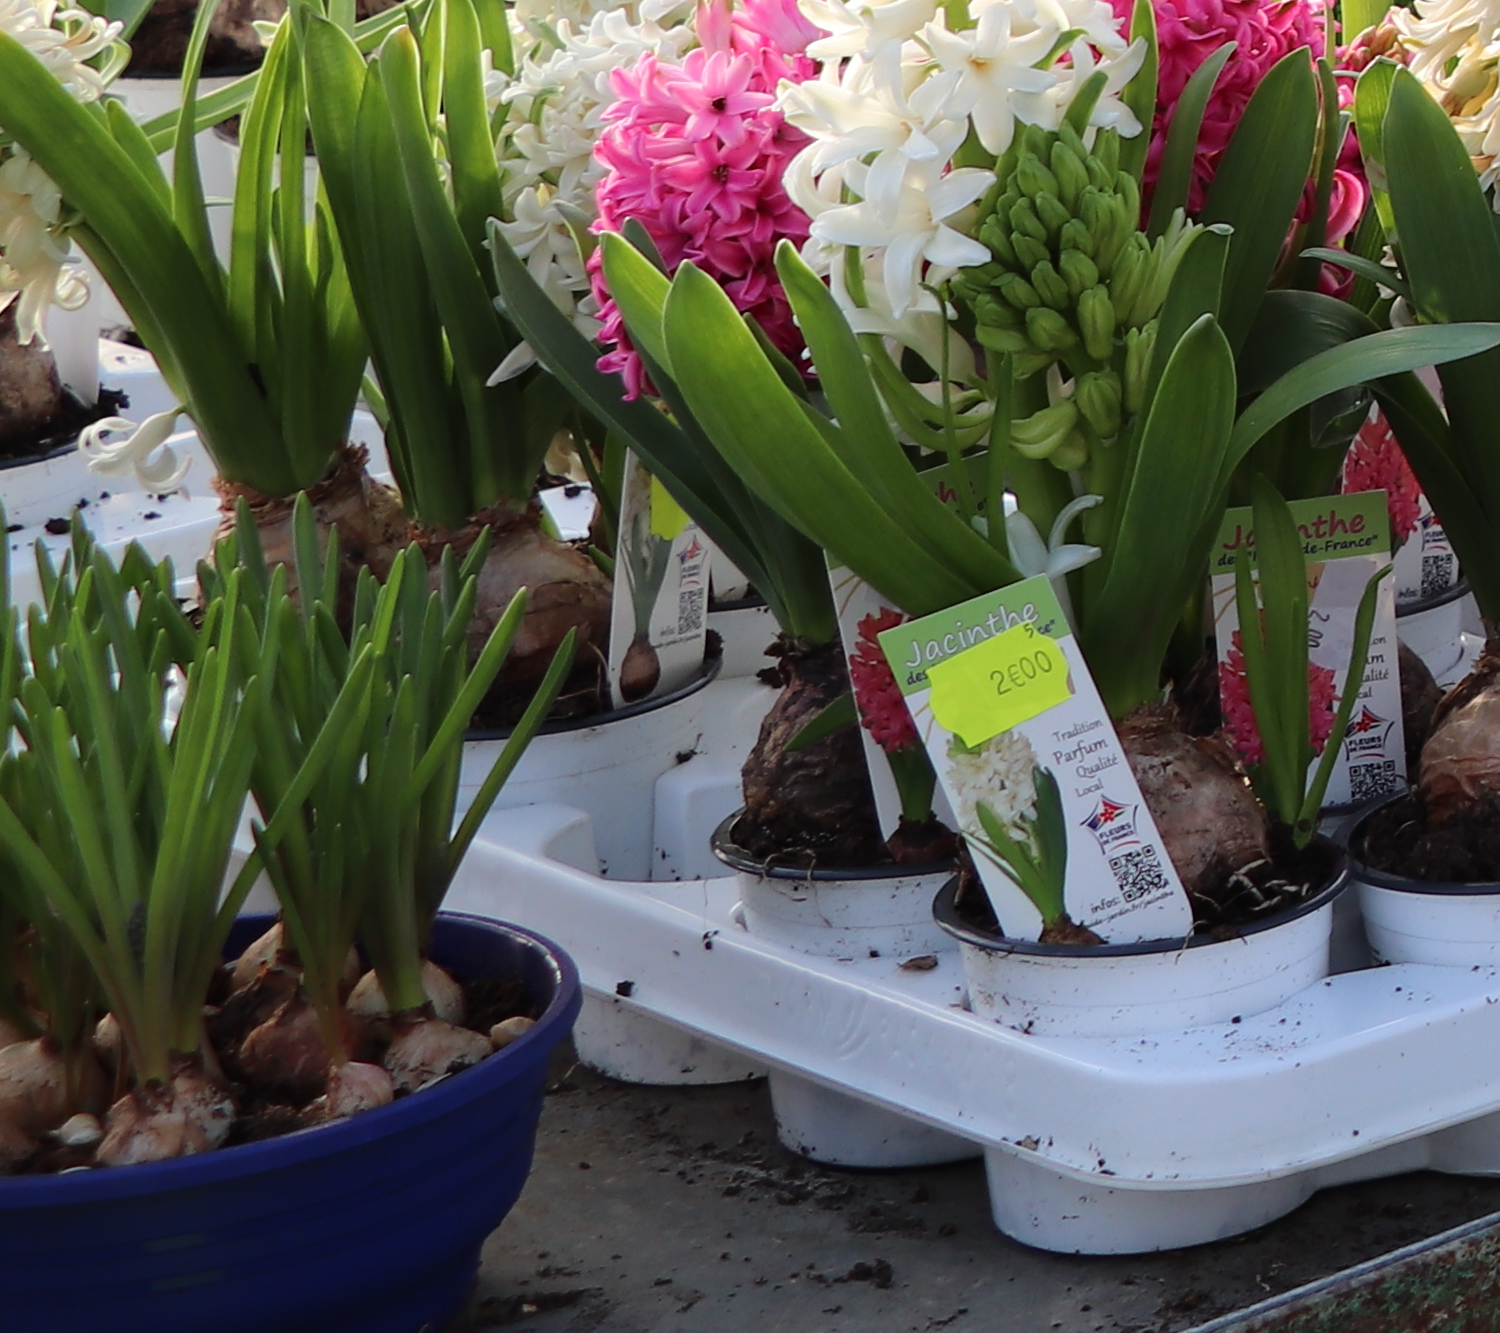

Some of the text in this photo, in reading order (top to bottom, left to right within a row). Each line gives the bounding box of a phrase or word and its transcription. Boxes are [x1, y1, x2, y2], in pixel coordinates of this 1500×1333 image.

[905, 602, 1039, 668] Jacinthe
[989, 650, 1053, 696] 2€00
[1052, 718, 1104, 743] Tradition
[1052, 738, 1109, 766] Parfum
[1076, 753, 1120, 779] Qualité
[1075, 777, 1106, 798] Local
